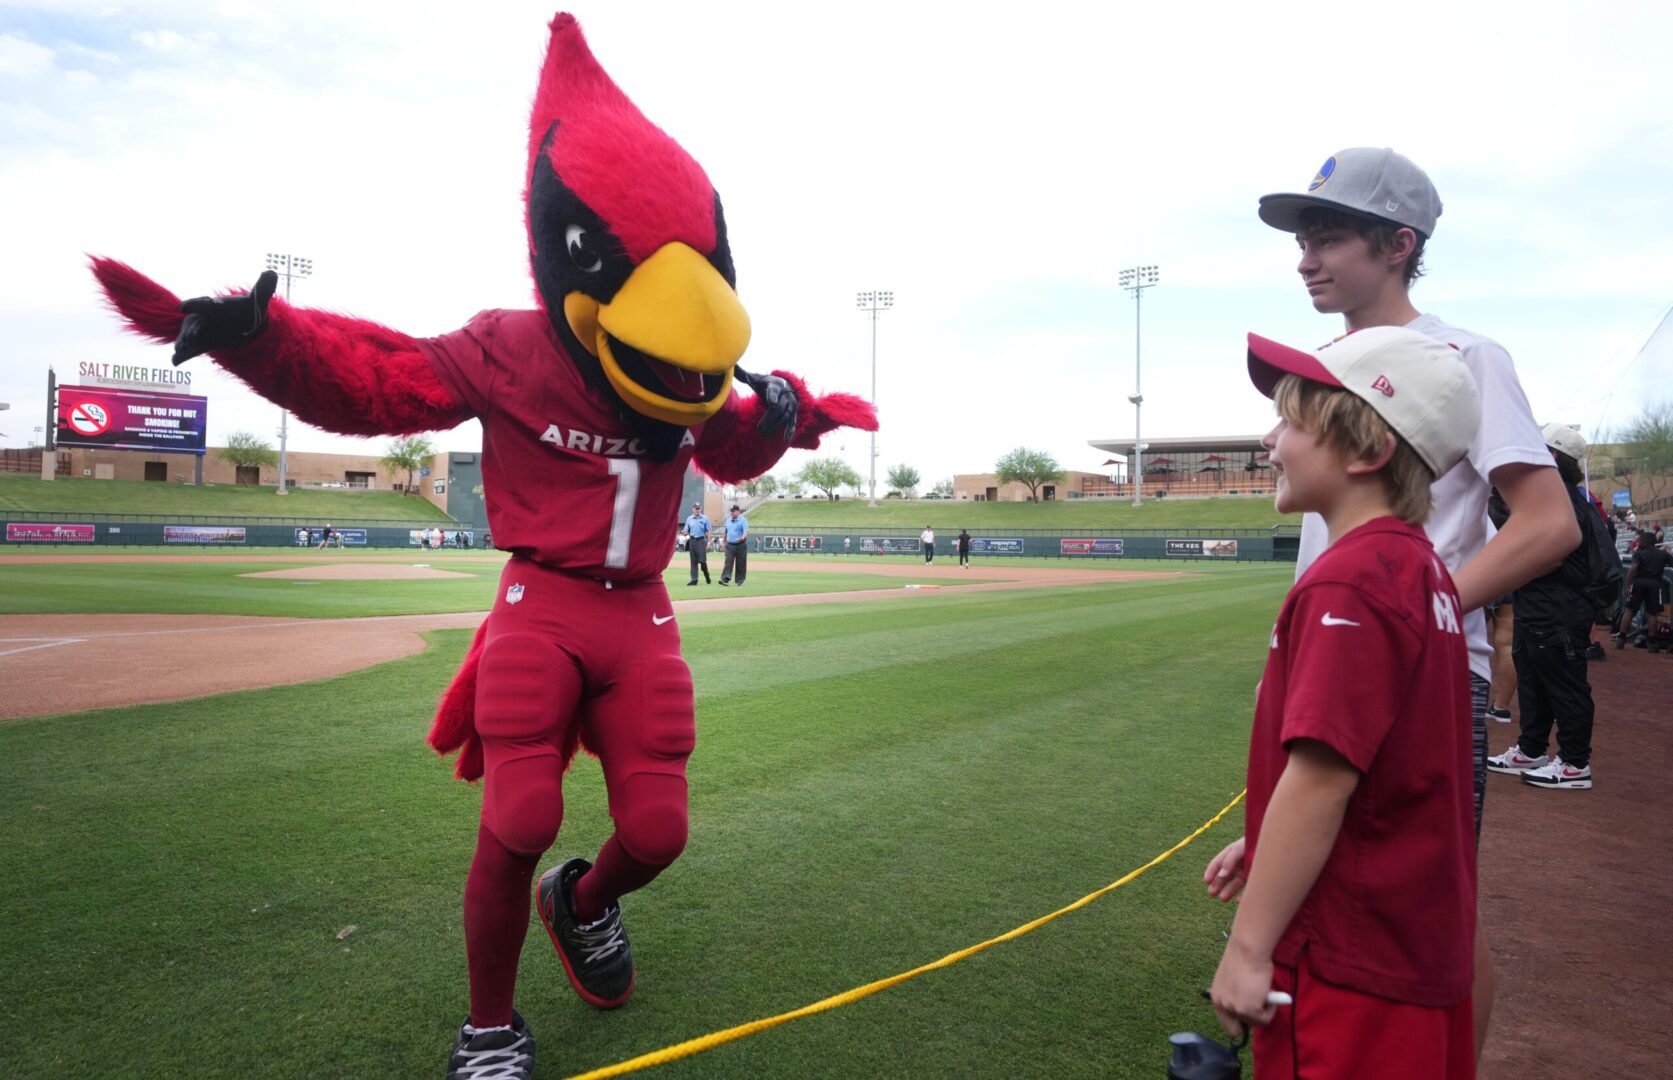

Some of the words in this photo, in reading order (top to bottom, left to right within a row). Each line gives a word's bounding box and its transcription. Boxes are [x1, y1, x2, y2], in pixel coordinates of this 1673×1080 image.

[79, 361, 109, 378] SALT
[113, 365, 149, 381] RIVER
[152, 369, 192, 385] FIELDS
[128, 405, 152, 415] THANK
[153, 407, 167, 416] YOU
[168, 408, 182, 417] FOR
[183, 409, 197, 419] NOT
[144, 417, 180, 429] SMOKING!
[604, 458, 641, 569] 1
